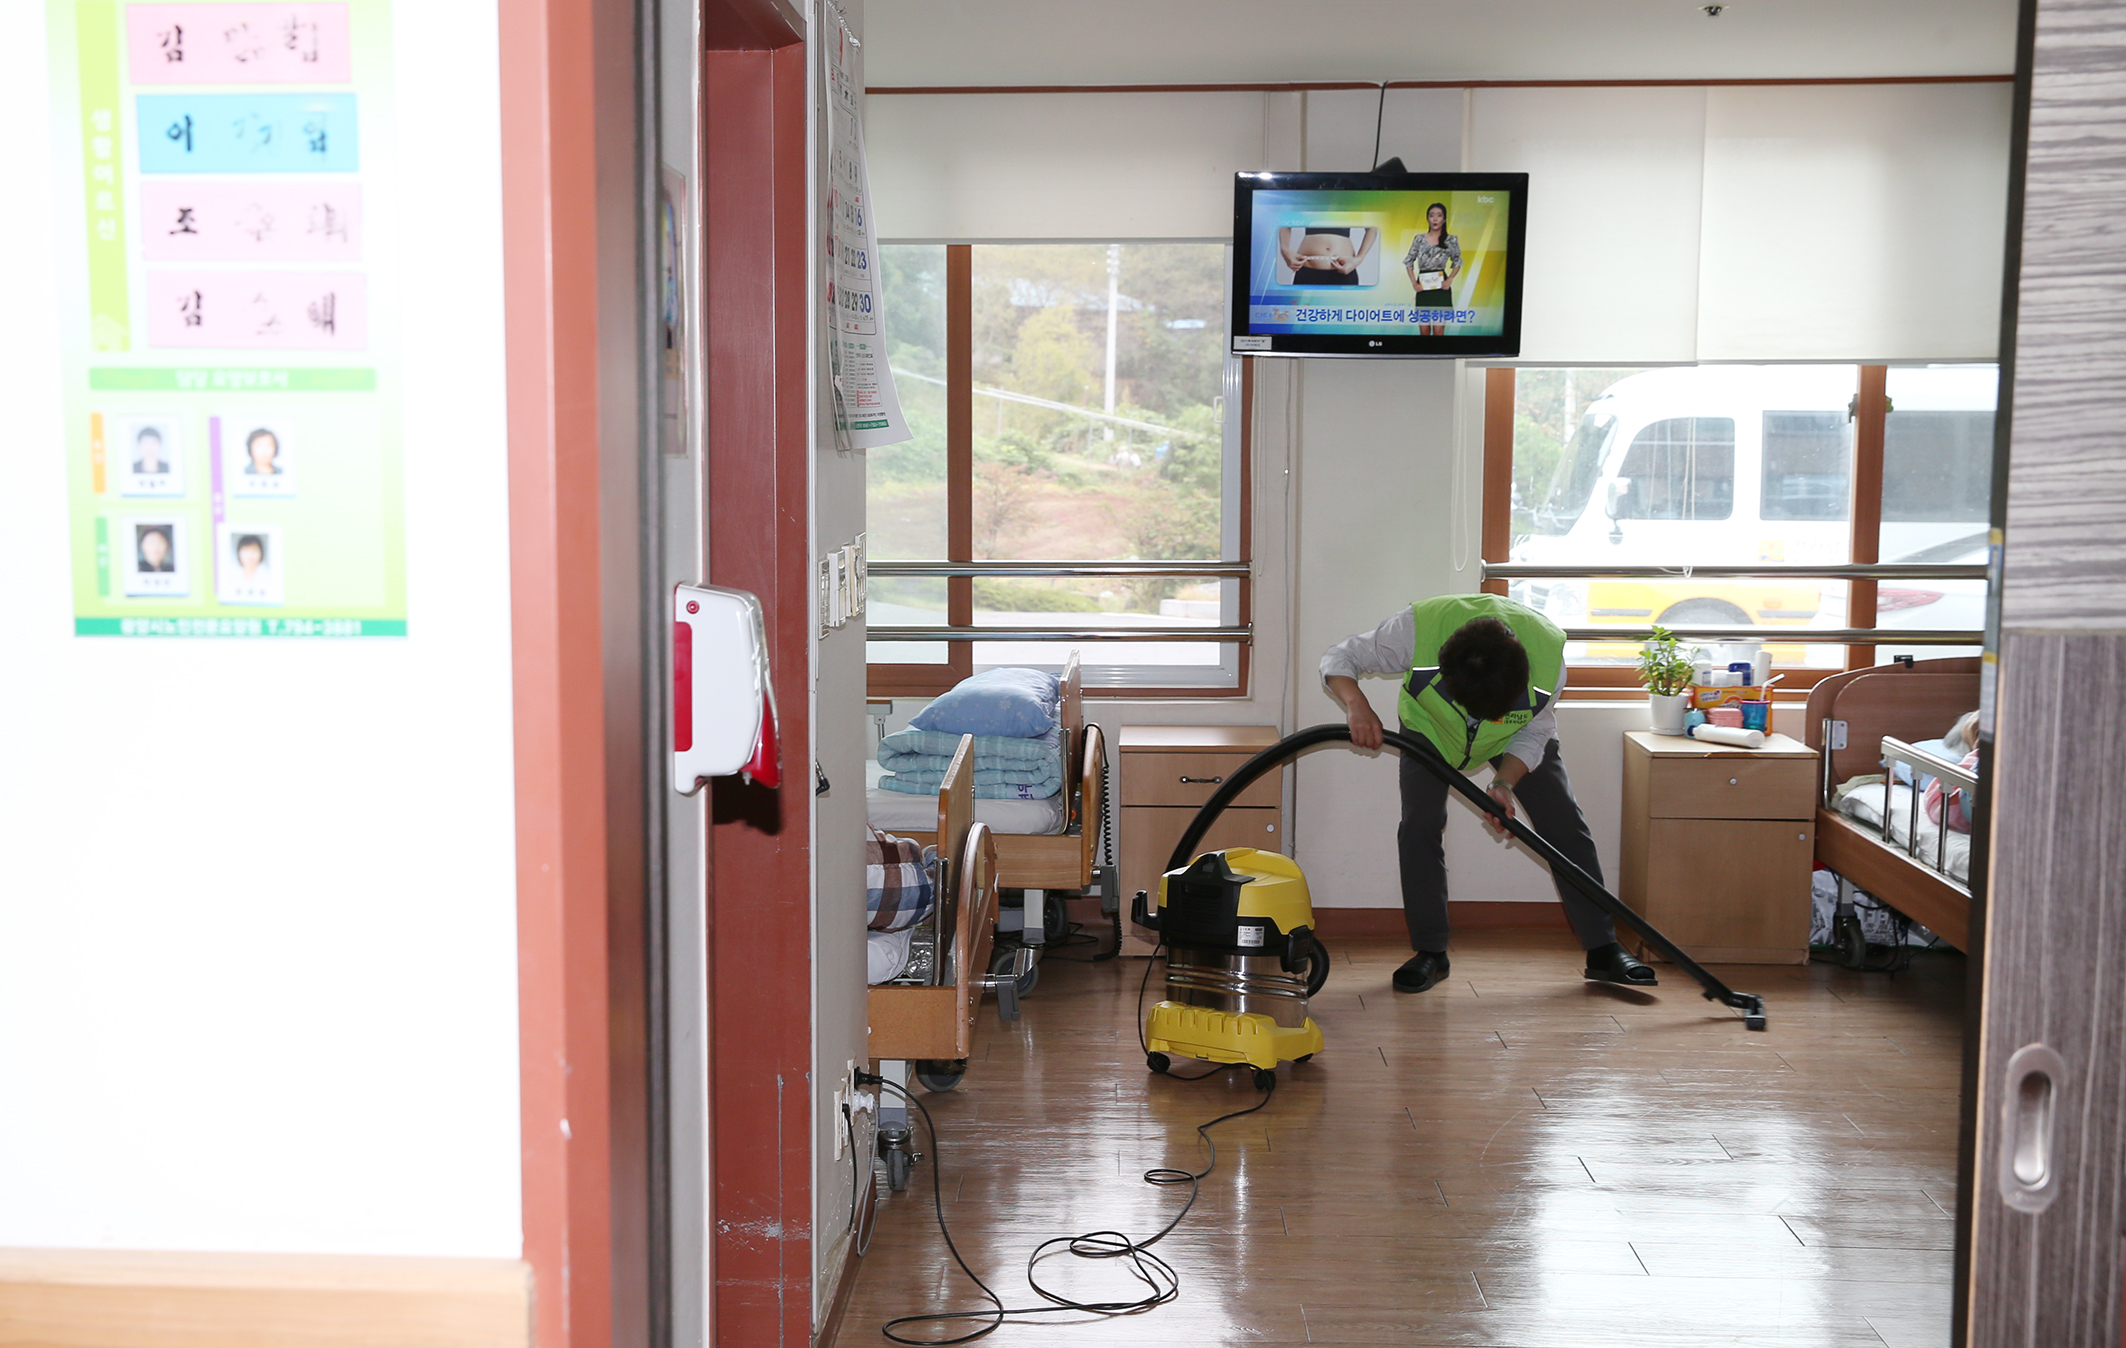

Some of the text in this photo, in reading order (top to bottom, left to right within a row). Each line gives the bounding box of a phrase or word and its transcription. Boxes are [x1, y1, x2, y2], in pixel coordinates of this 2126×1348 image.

[1477, 195, 1495, 204] kbc
[857, 251, 867, 270] 23
[859, 293, 871, 313] 30
[1296, 308, 1343, 322] 건강하게
[1345, 309, 1405, 322] 다이어트에
[1407, 309, 1476, 323] 성공하려면?
